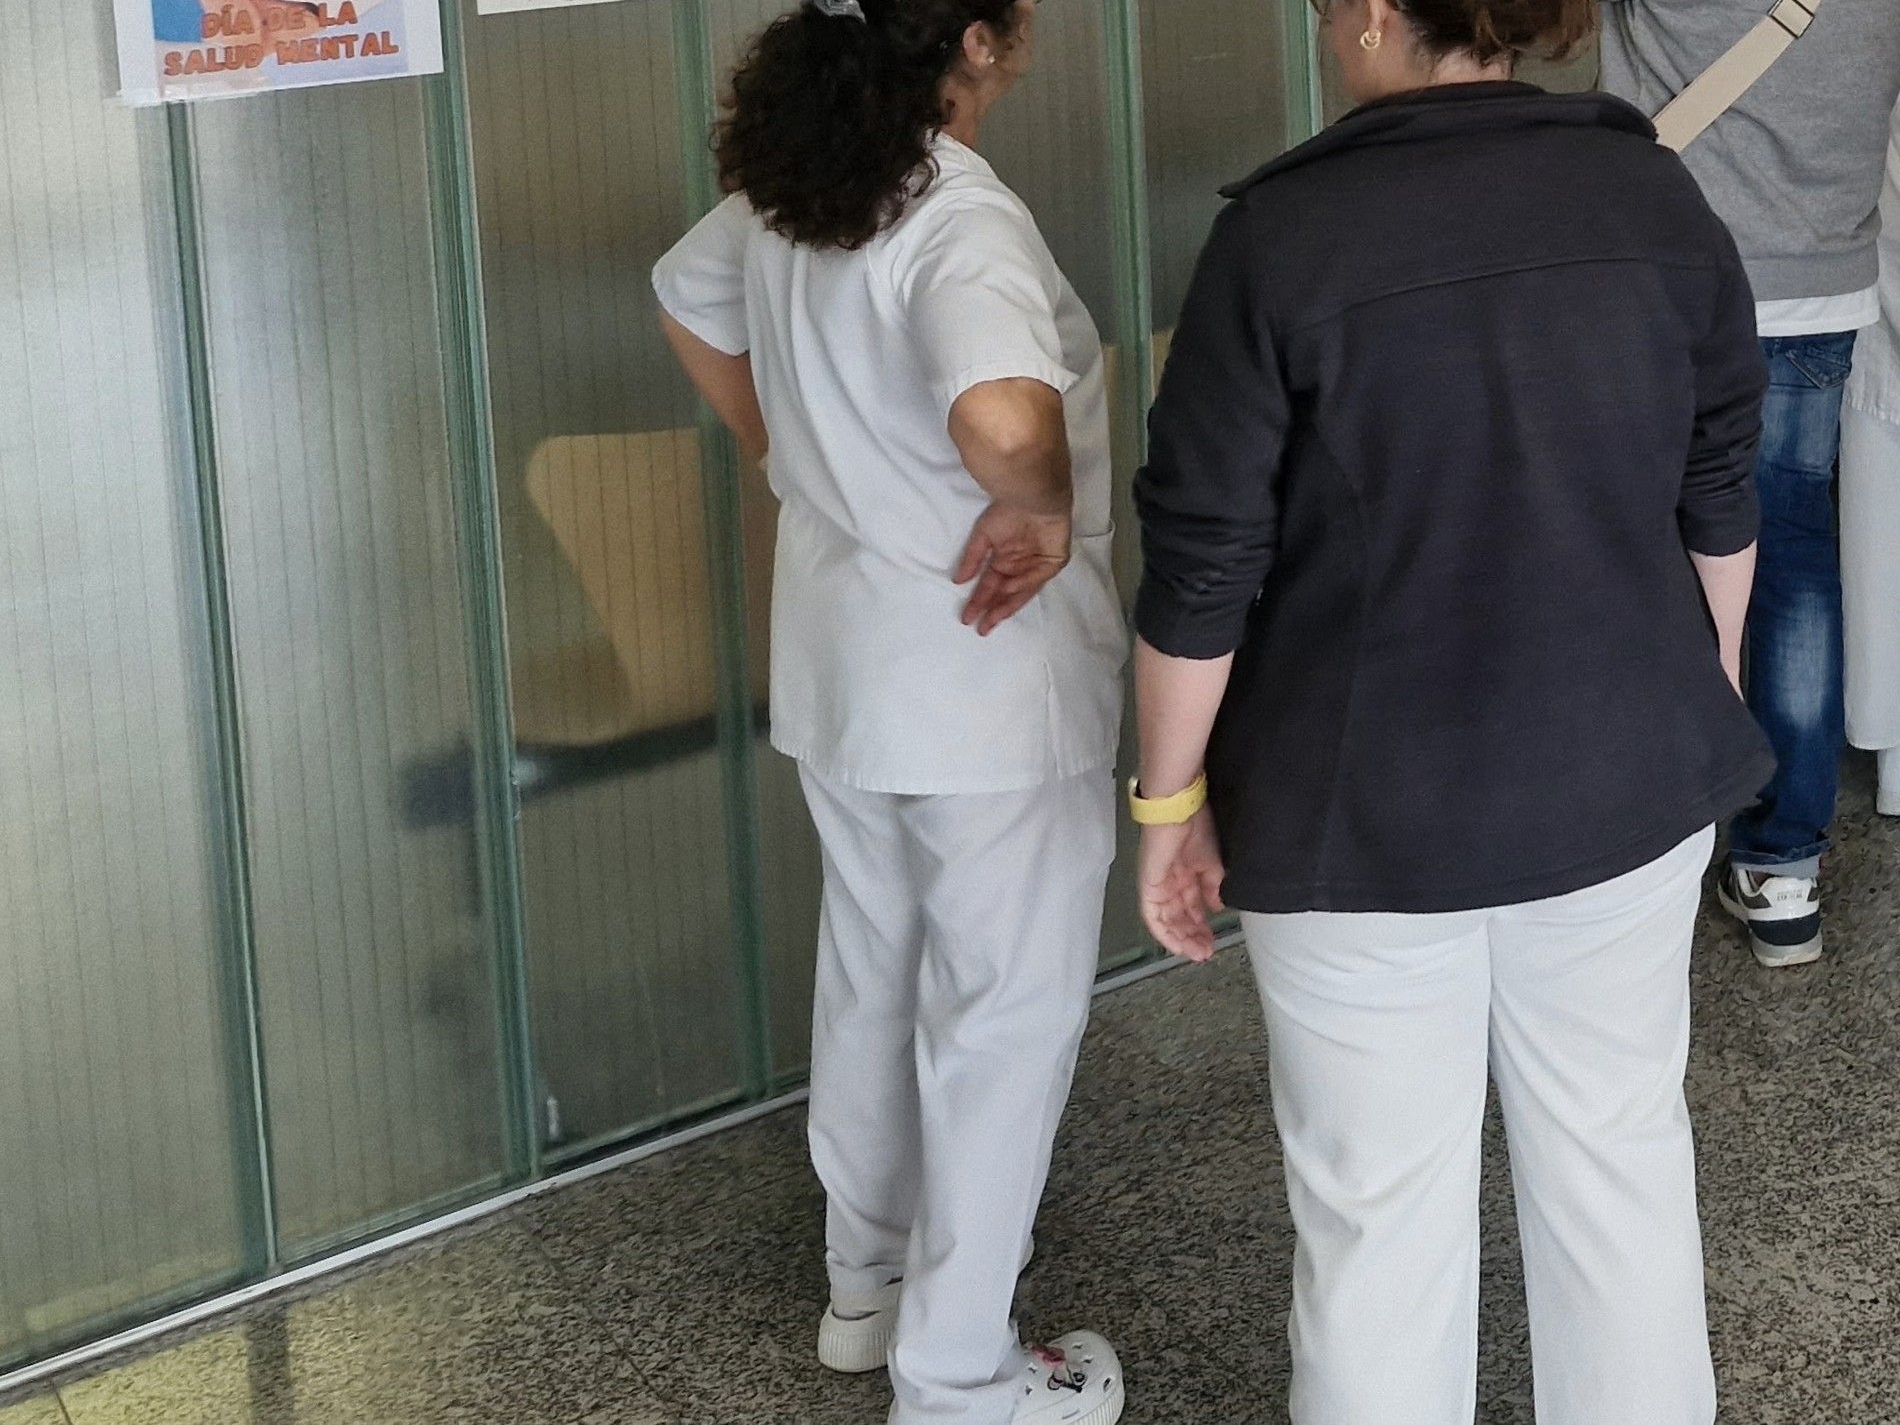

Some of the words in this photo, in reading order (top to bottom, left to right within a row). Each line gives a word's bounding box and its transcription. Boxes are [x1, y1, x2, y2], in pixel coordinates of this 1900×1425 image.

[201, 9, 255, 39] DÍA
[267, 6, 306, 30] DE
[316, 0, 358, 28] LA
[163, 43, 265, 76] SALUD
[276, 31, 400, 65] MENTAL
